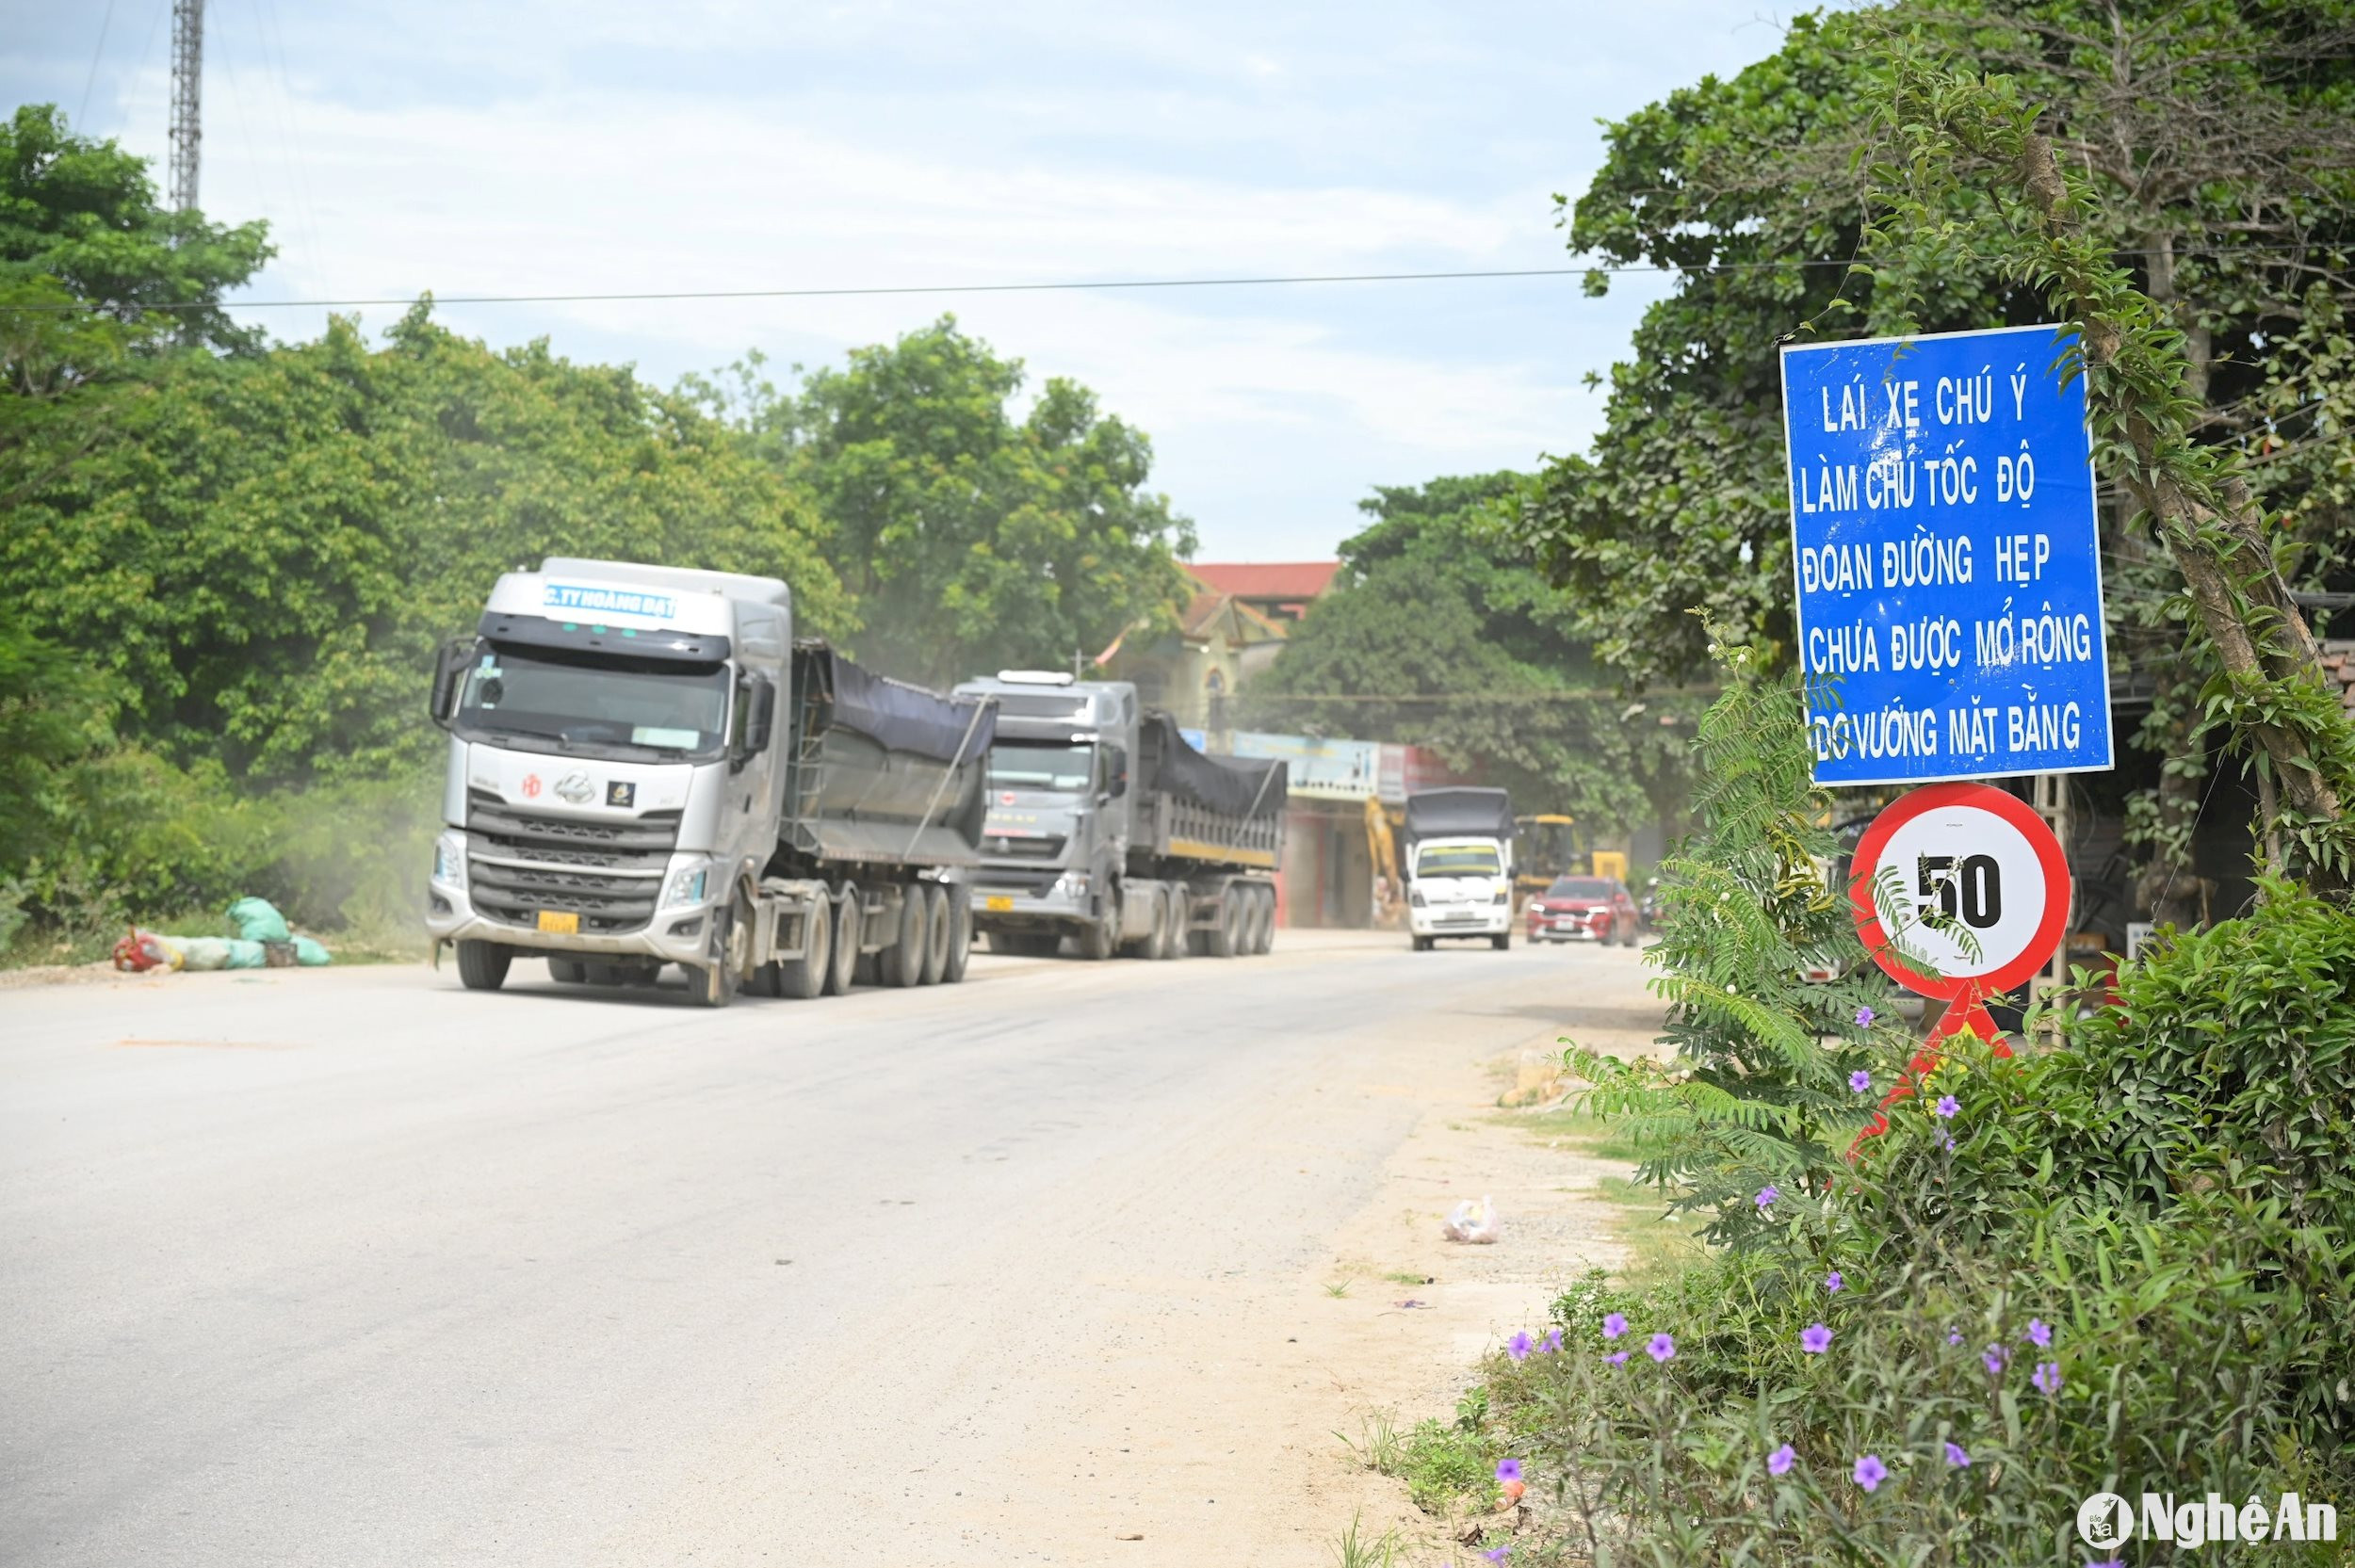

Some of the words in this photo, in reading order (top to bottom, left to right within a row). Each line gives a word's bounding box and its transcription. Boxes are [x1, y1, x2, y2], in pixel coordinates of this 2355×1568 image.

[1885, 380, 1920, 428] XE
[1936, 364, 1992, 425] CHÚ
[2010, 363, 2026, 421] Ý
[1801, 453, 1858, 512] LÀM
[1924, 439, 1977, 506] TỐC
[1996, 439, 2035, 509] ĐỘ
[1802, 543, 1873, 597] ĐOẠN
[1882, 524, 1973, 588] ĐƯỜNG
[1995, 533, 2050, 589] HẸP
[1809, 619, 1879, 674] CHƯA
[1891, 615, 1961, 675] ĐƯỢC
[1975, 595, 2013, 667] MỞ
[2022, 601, 2091, 670] RỘNG
[1814, 712, 1849, 762] DO
[1852, 695, 1938, 759] VƯỚNG
[1949, 694, 1998, 761] MẶT
[2007, 683, 2080, 752] BẰNG
[1917, 854, 2002, 929] 50
